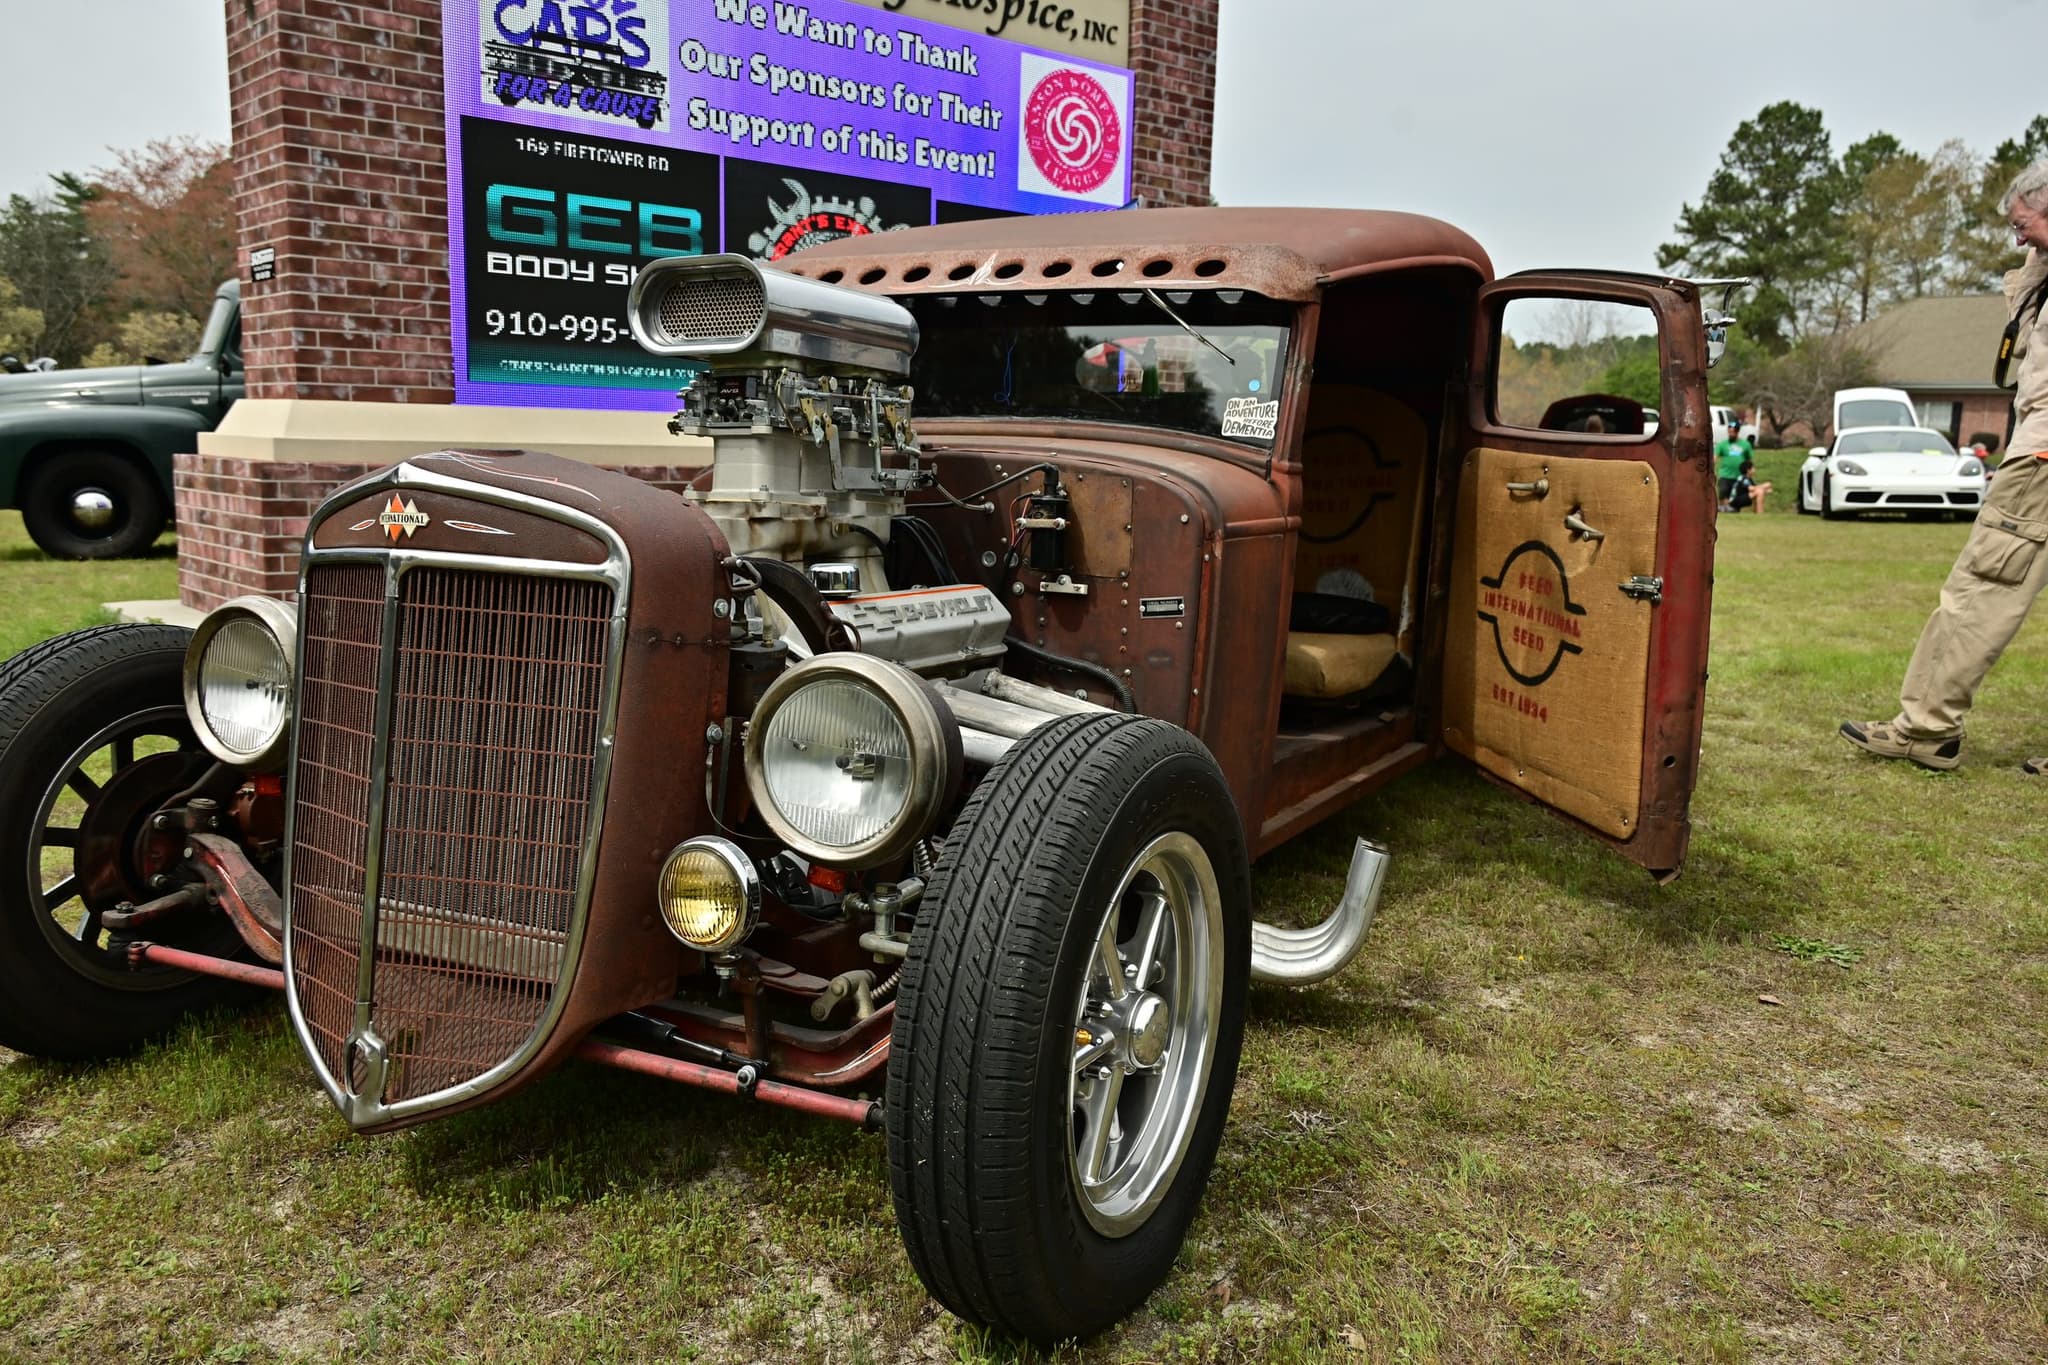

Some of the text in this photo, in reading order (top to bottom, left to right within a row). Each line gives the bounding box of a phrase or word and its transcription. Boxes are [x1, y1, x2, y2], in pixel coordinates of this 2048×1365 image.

[773, 2, 857, 49] Want
[862, 27, 893, 57] to
[897, 30, 979, 77] Thank
[1083, 20, 1118, 45] INC
[496, 71, 658, 121] FOR A CAUSE
[679, 39, 1003, 131] Our Sponsors for Their
[687, 97, 997, 179] Support of this Event!
[486, 183, 703, 259] GEB
[487, 251, 594, 282] BODY
[1226, 404, 1275, 417] ADVENTURE
[1228, 401, 1240, 409] ON
[1224, 419, 1273, 436] DEMENTIA
[1512, 626, 1545, 653] SEED
